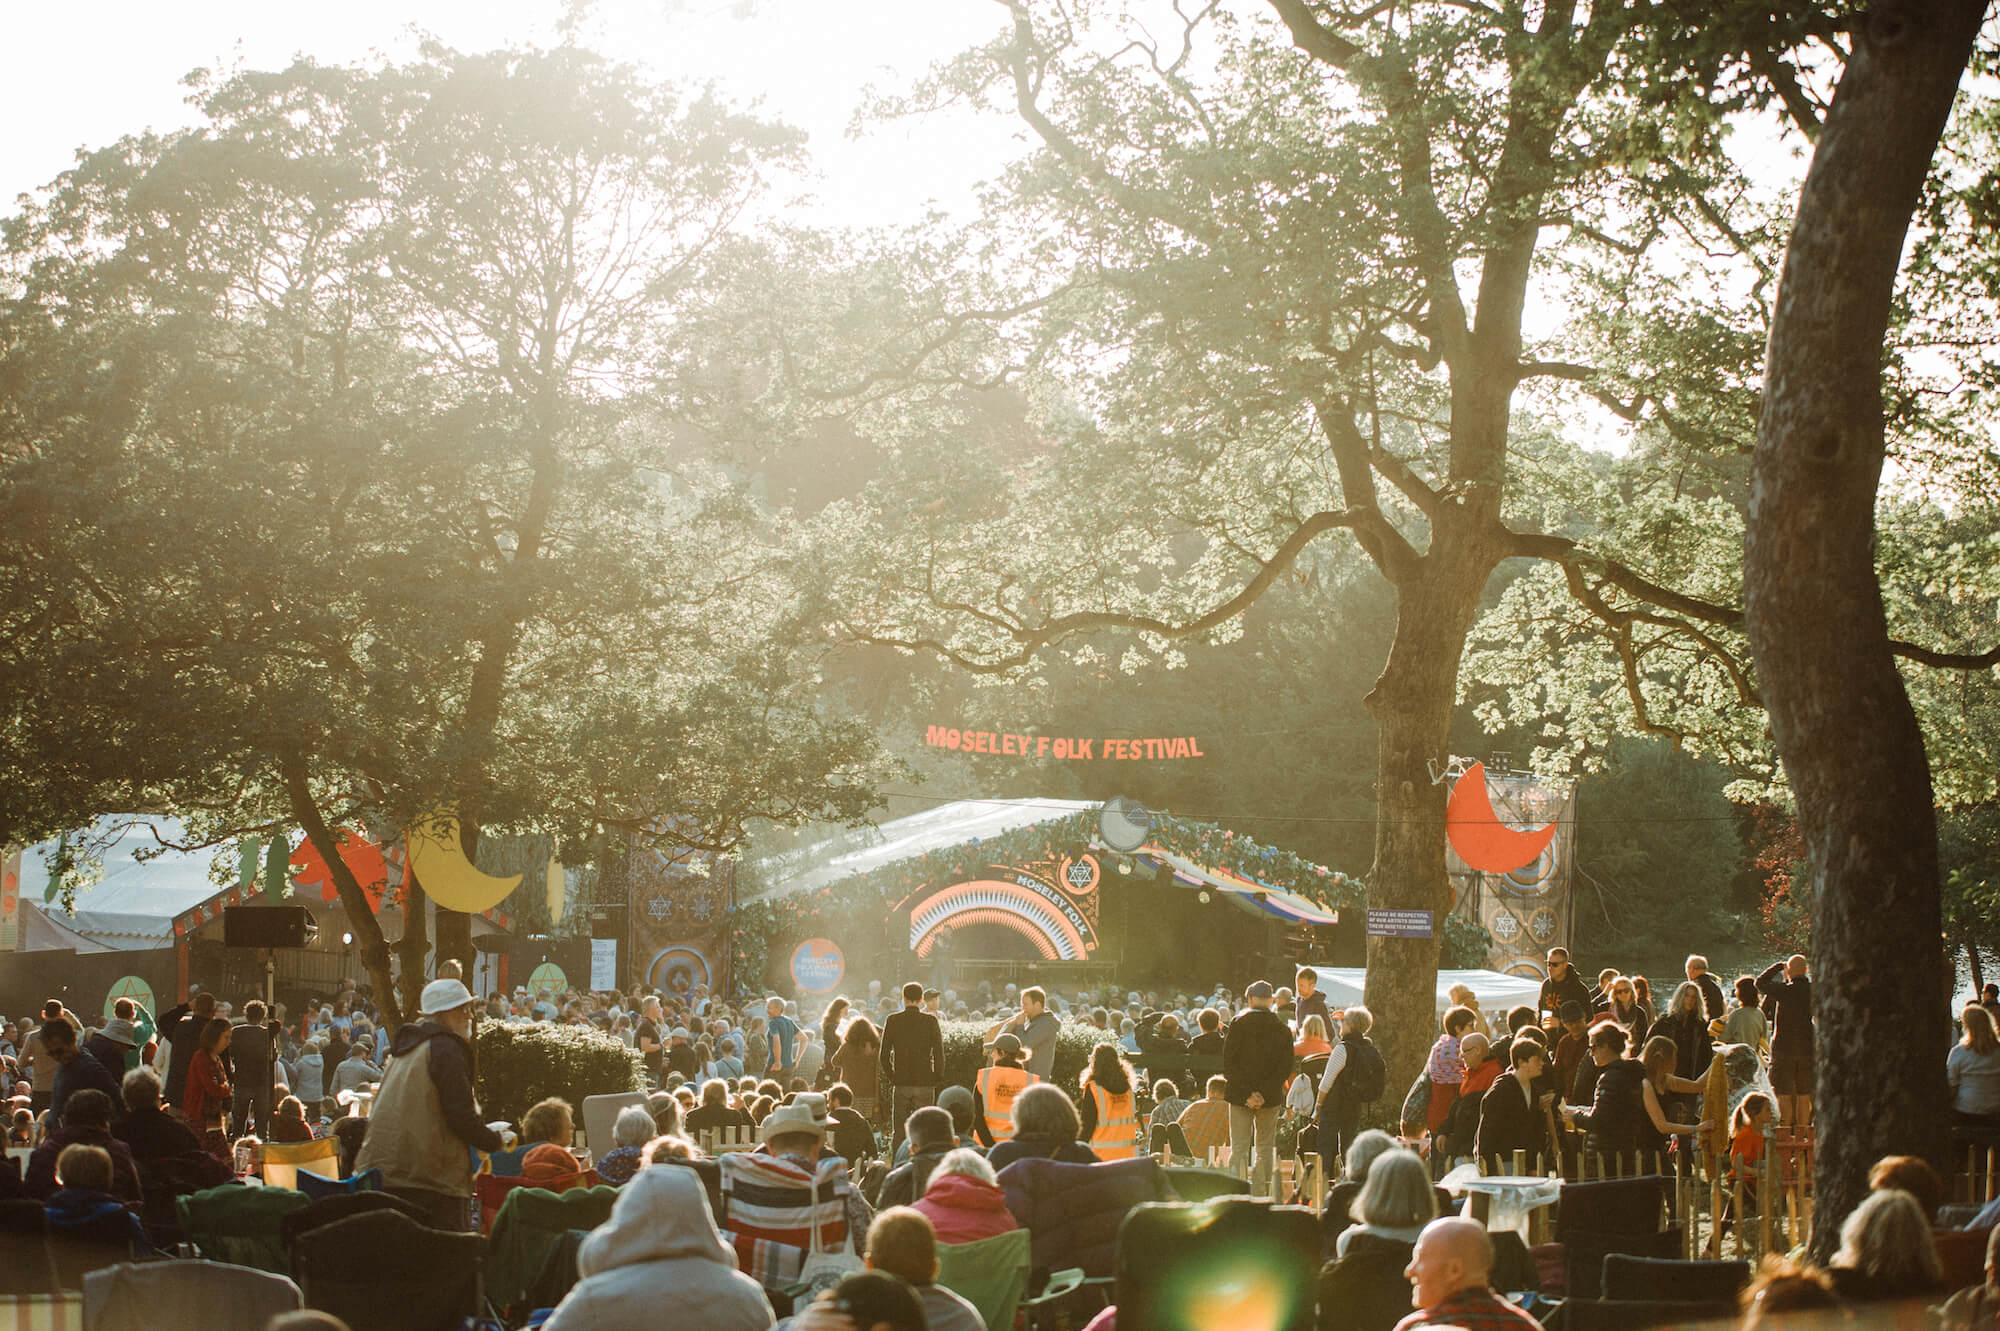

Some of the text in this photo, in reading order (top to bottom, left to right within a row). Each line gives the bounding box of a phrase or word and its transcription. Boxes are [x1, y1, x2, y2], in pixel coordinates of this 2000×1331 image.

[926, 725, 1204, 760] MOSELEY FOLK FESTIVAL
[1016, 875, 1088, 935] MOSELEY FOLK
